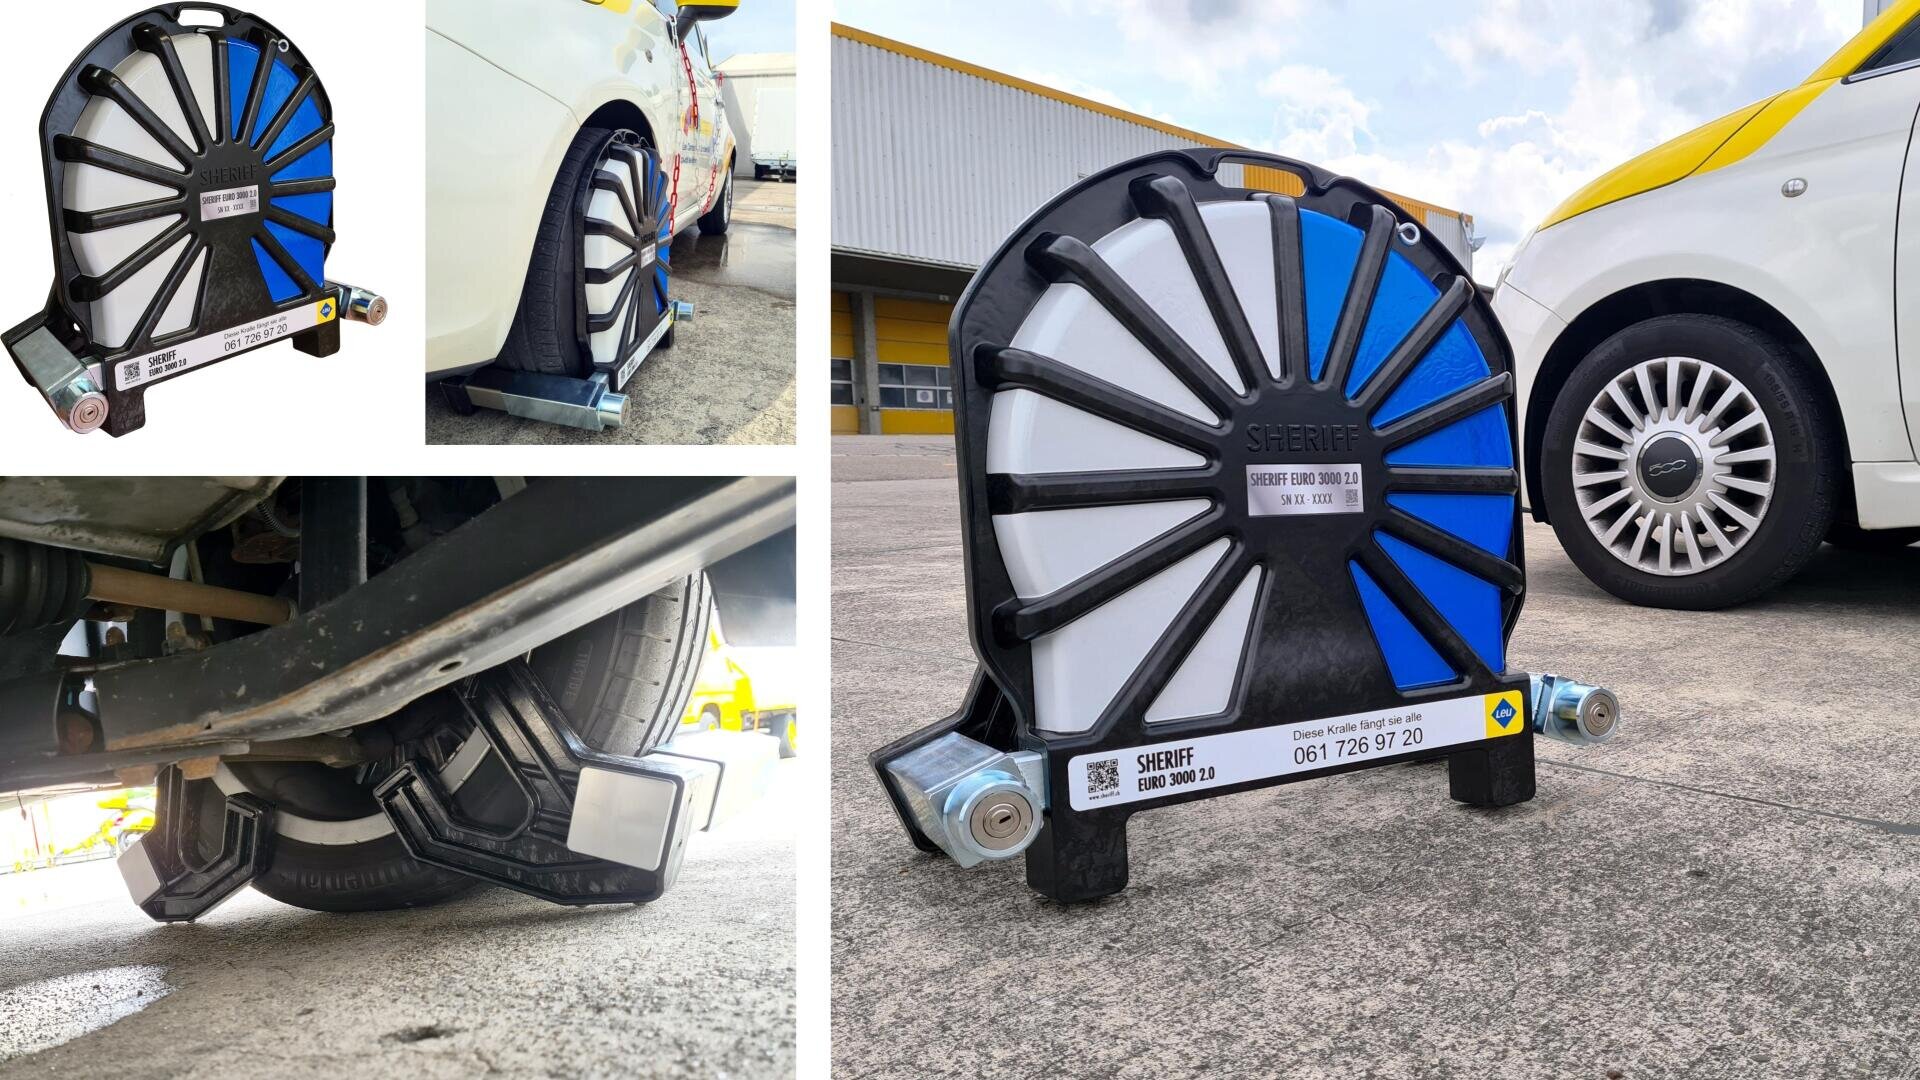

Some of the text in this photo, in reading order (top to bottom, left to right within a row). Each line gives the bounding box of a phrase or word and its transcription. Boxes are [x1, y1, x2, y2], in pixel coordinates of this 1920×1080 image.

[202, 195, 221, 205] SHERIFF
[222, 193, 235, 202] EURO
[236, 191, 248, 200] 3000
[224, 323, 288, 352] 061 726 97 20
[148, 349, 177, 368] SHERIFF
[148, 358, 187, 377] EURO 3000 2.0
[1246, 423, 1360, 453] SHERIFF
[1250, 471, 1358, 487] SHERIFF EURO 3000 2.0
[1281, 494, 1292, 505] SN
[1294, 493, 1305, 505] XX
[1312, 492, 1333, 505] XXXX
[1293, 712, 1422, 741] Diese Kralle fängt sie alle
[1293, 727, 1423, 765] 061 726 97 20
[1137, 746, 1194, 774] SHERIFF
[1138, 766, 1215, 792] EURO 3000 2.0
